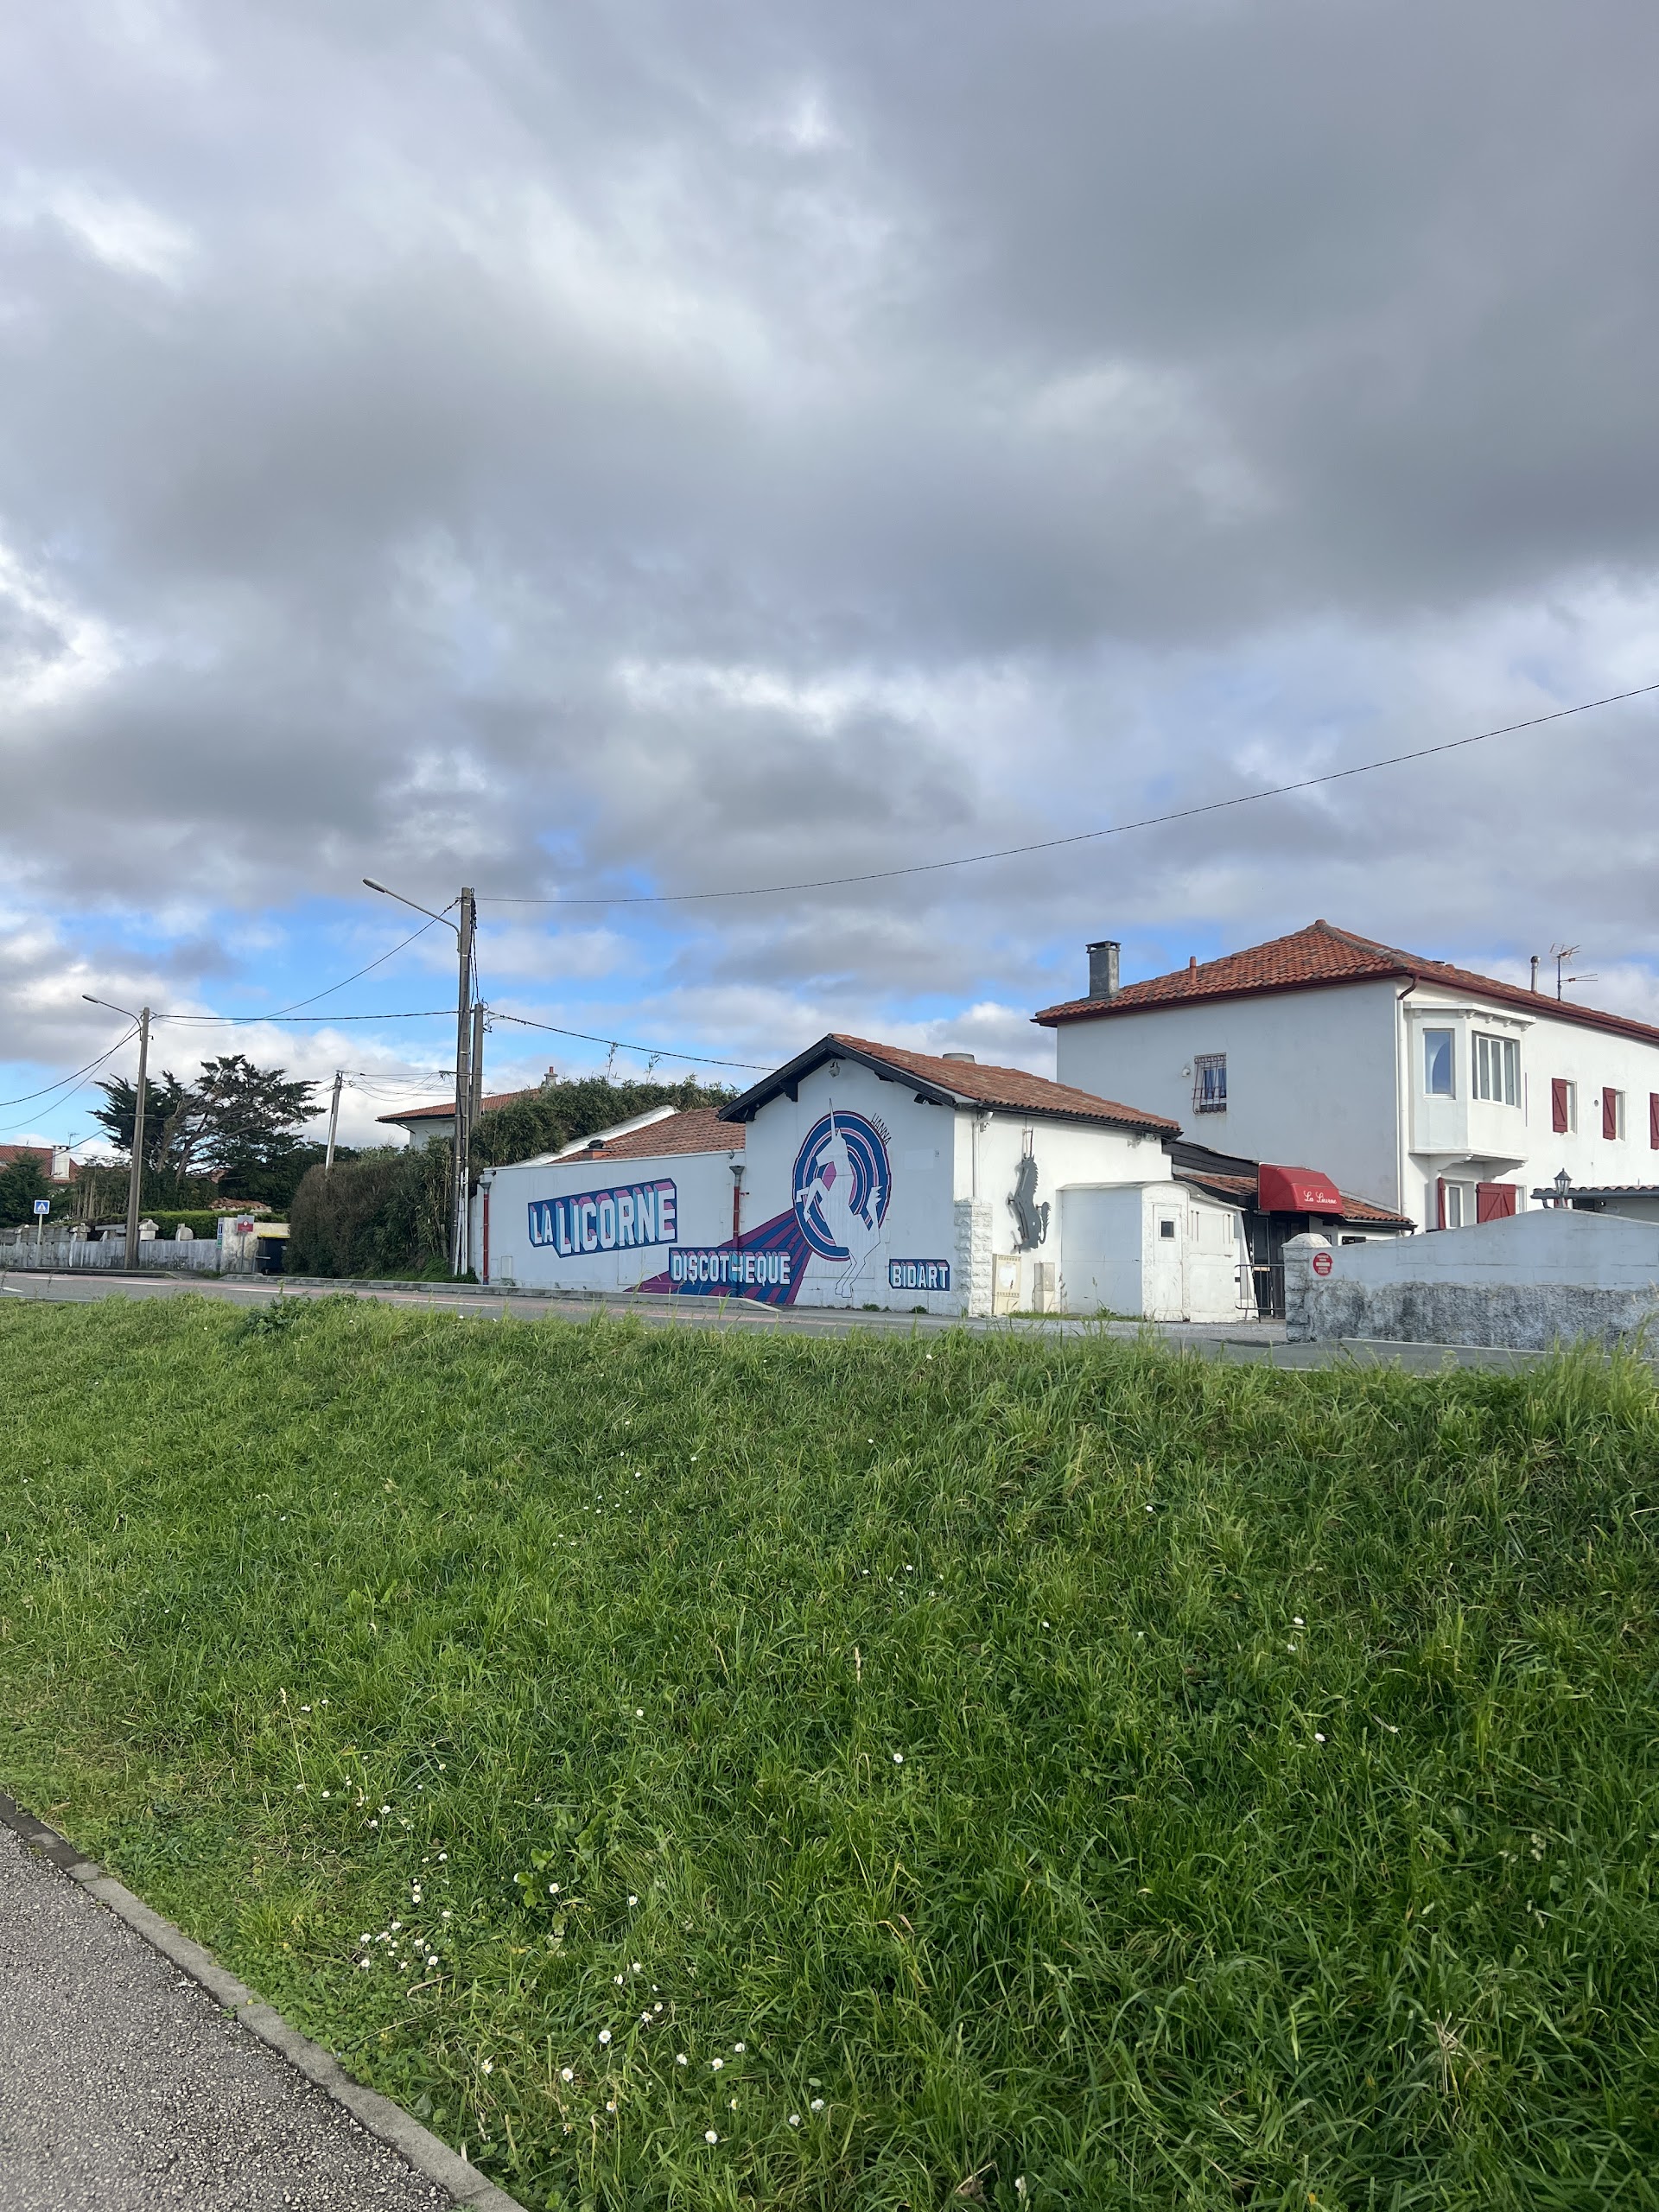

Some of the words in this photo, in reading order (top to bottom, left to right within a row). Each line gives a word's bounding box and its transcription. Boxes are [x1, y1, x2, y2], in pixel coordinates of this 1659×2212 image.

[530, 1205, 554, 1244] LA
[556, 1182, 676, 1254] LICORNE
[671, 1251, 791, 1287] DISCOTHEQUE
[891, 1262, 949, 1288] BIDART
